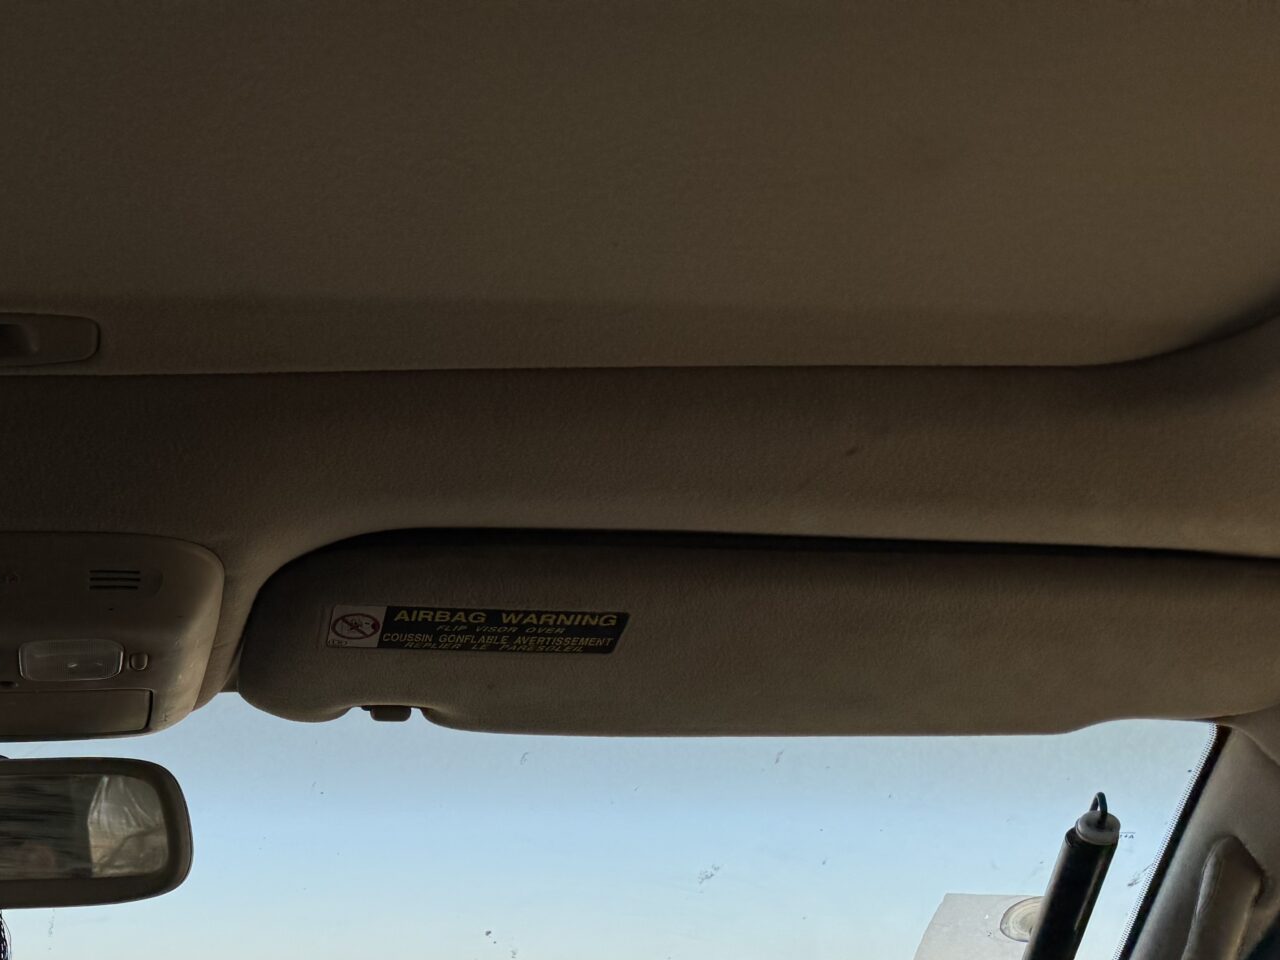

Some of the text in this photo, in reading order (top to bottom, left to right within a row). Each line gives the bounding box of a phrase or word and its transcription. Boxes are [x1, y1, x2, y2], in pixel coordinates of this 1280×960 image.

[393, 609, 618, 626] AIRBAG WARNING
[382, 633, 614, 647] COUSSIN GONFLABLE AVERTISSEMENT
